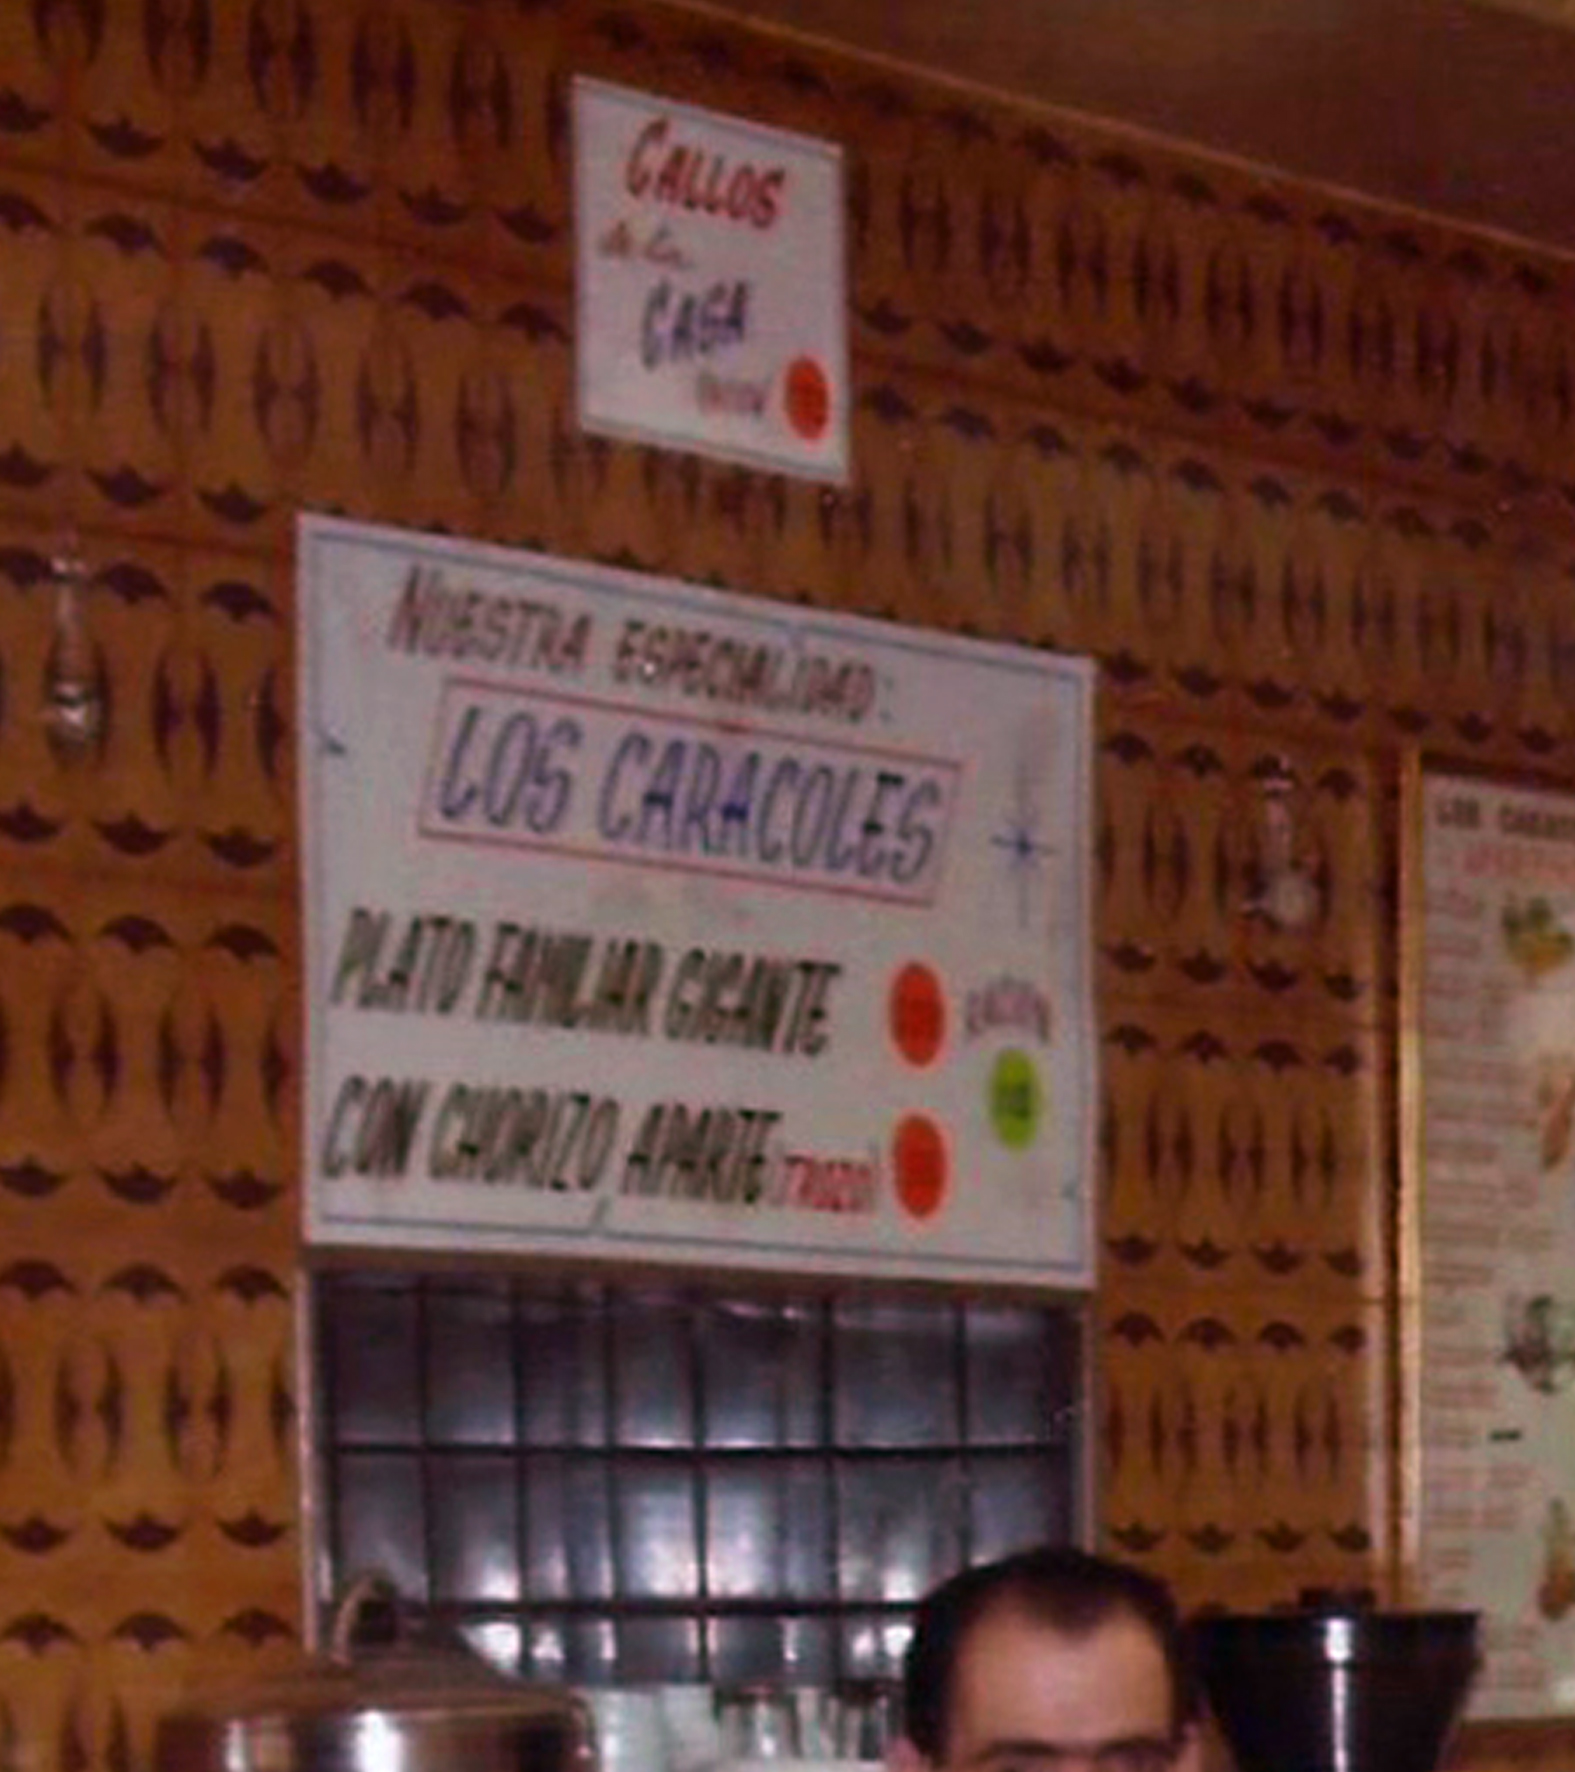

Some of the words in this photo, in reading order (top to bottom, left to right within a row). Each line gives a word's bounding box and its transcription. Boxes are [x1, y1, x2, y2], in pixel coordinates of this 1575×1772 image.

[626, 118, 786, 229] CALLOS
[638, 274, 751, 373] CASA
[388, 564, 588, 678] NUESTRA
[438, 704, 585, 836] LOS
[600, 728, 944, 884] CARACOLES
[331, 904, 477, 1017] PLATO
[475, 921, 666, 1038] FAMILIAR
[663, 946, 844, 1057] GIGANTE
[320, 1073, 430, 1182] CON
[427, 1080, 622, 1194] CHORIZO
[619, 1102, 784, 1206] APARTE
